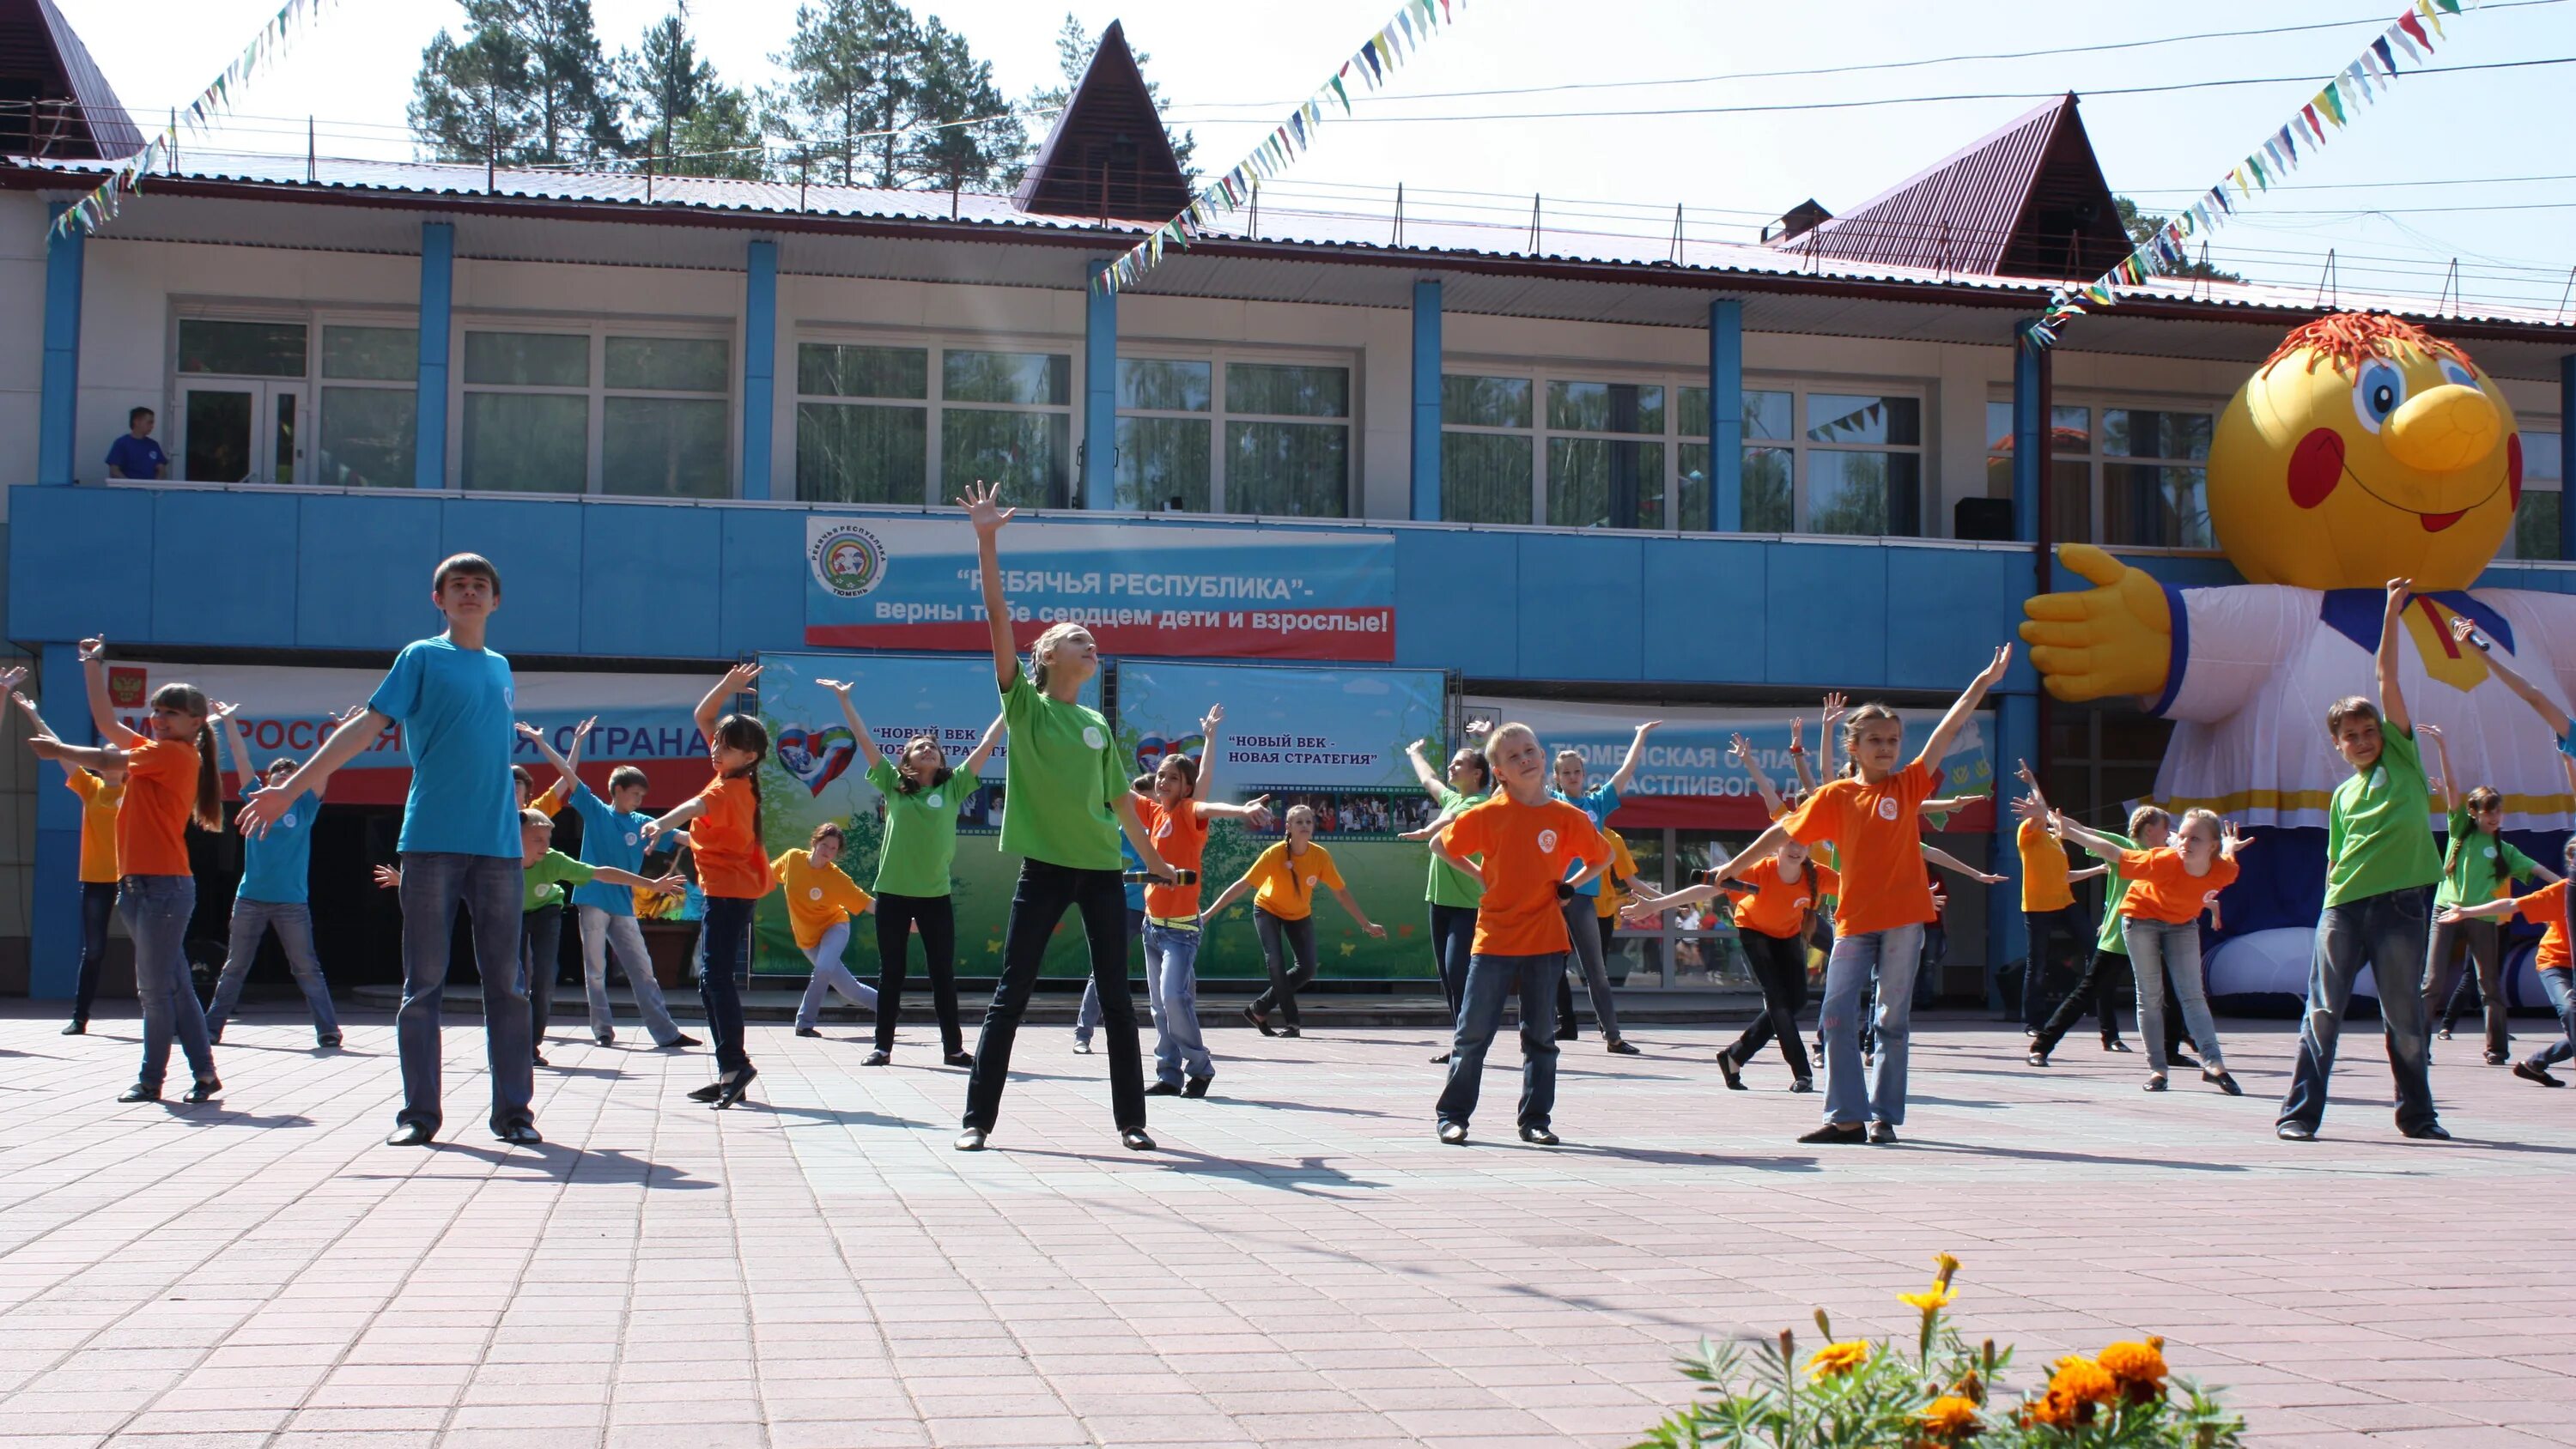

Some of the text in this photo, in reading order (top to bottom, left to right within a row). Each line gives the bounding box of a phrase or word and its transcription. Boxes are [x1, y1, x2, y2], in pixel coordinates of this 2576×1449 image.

[811, 525, 886, 561] РЕБЯЧЬЯ РЕСПУБЛИКА
[833, 588, 868, 597] ТЮМЕНЬ
[876, 602, 962, 624] верны
[1038, 606, 1151, 627] сердцем
[1158, 609, 1220, 630] дети
[1229, 612, 1243, 627] и
[1252, 611, 1388, 634] взрослые!
[230, 719, 401, 752] РОССЯ
[945, 729, 976, 740] ВЕК
[1297, 737, 1327, 749] ВЕК
[1229, 752, 1279, 763] НОВАЯ
